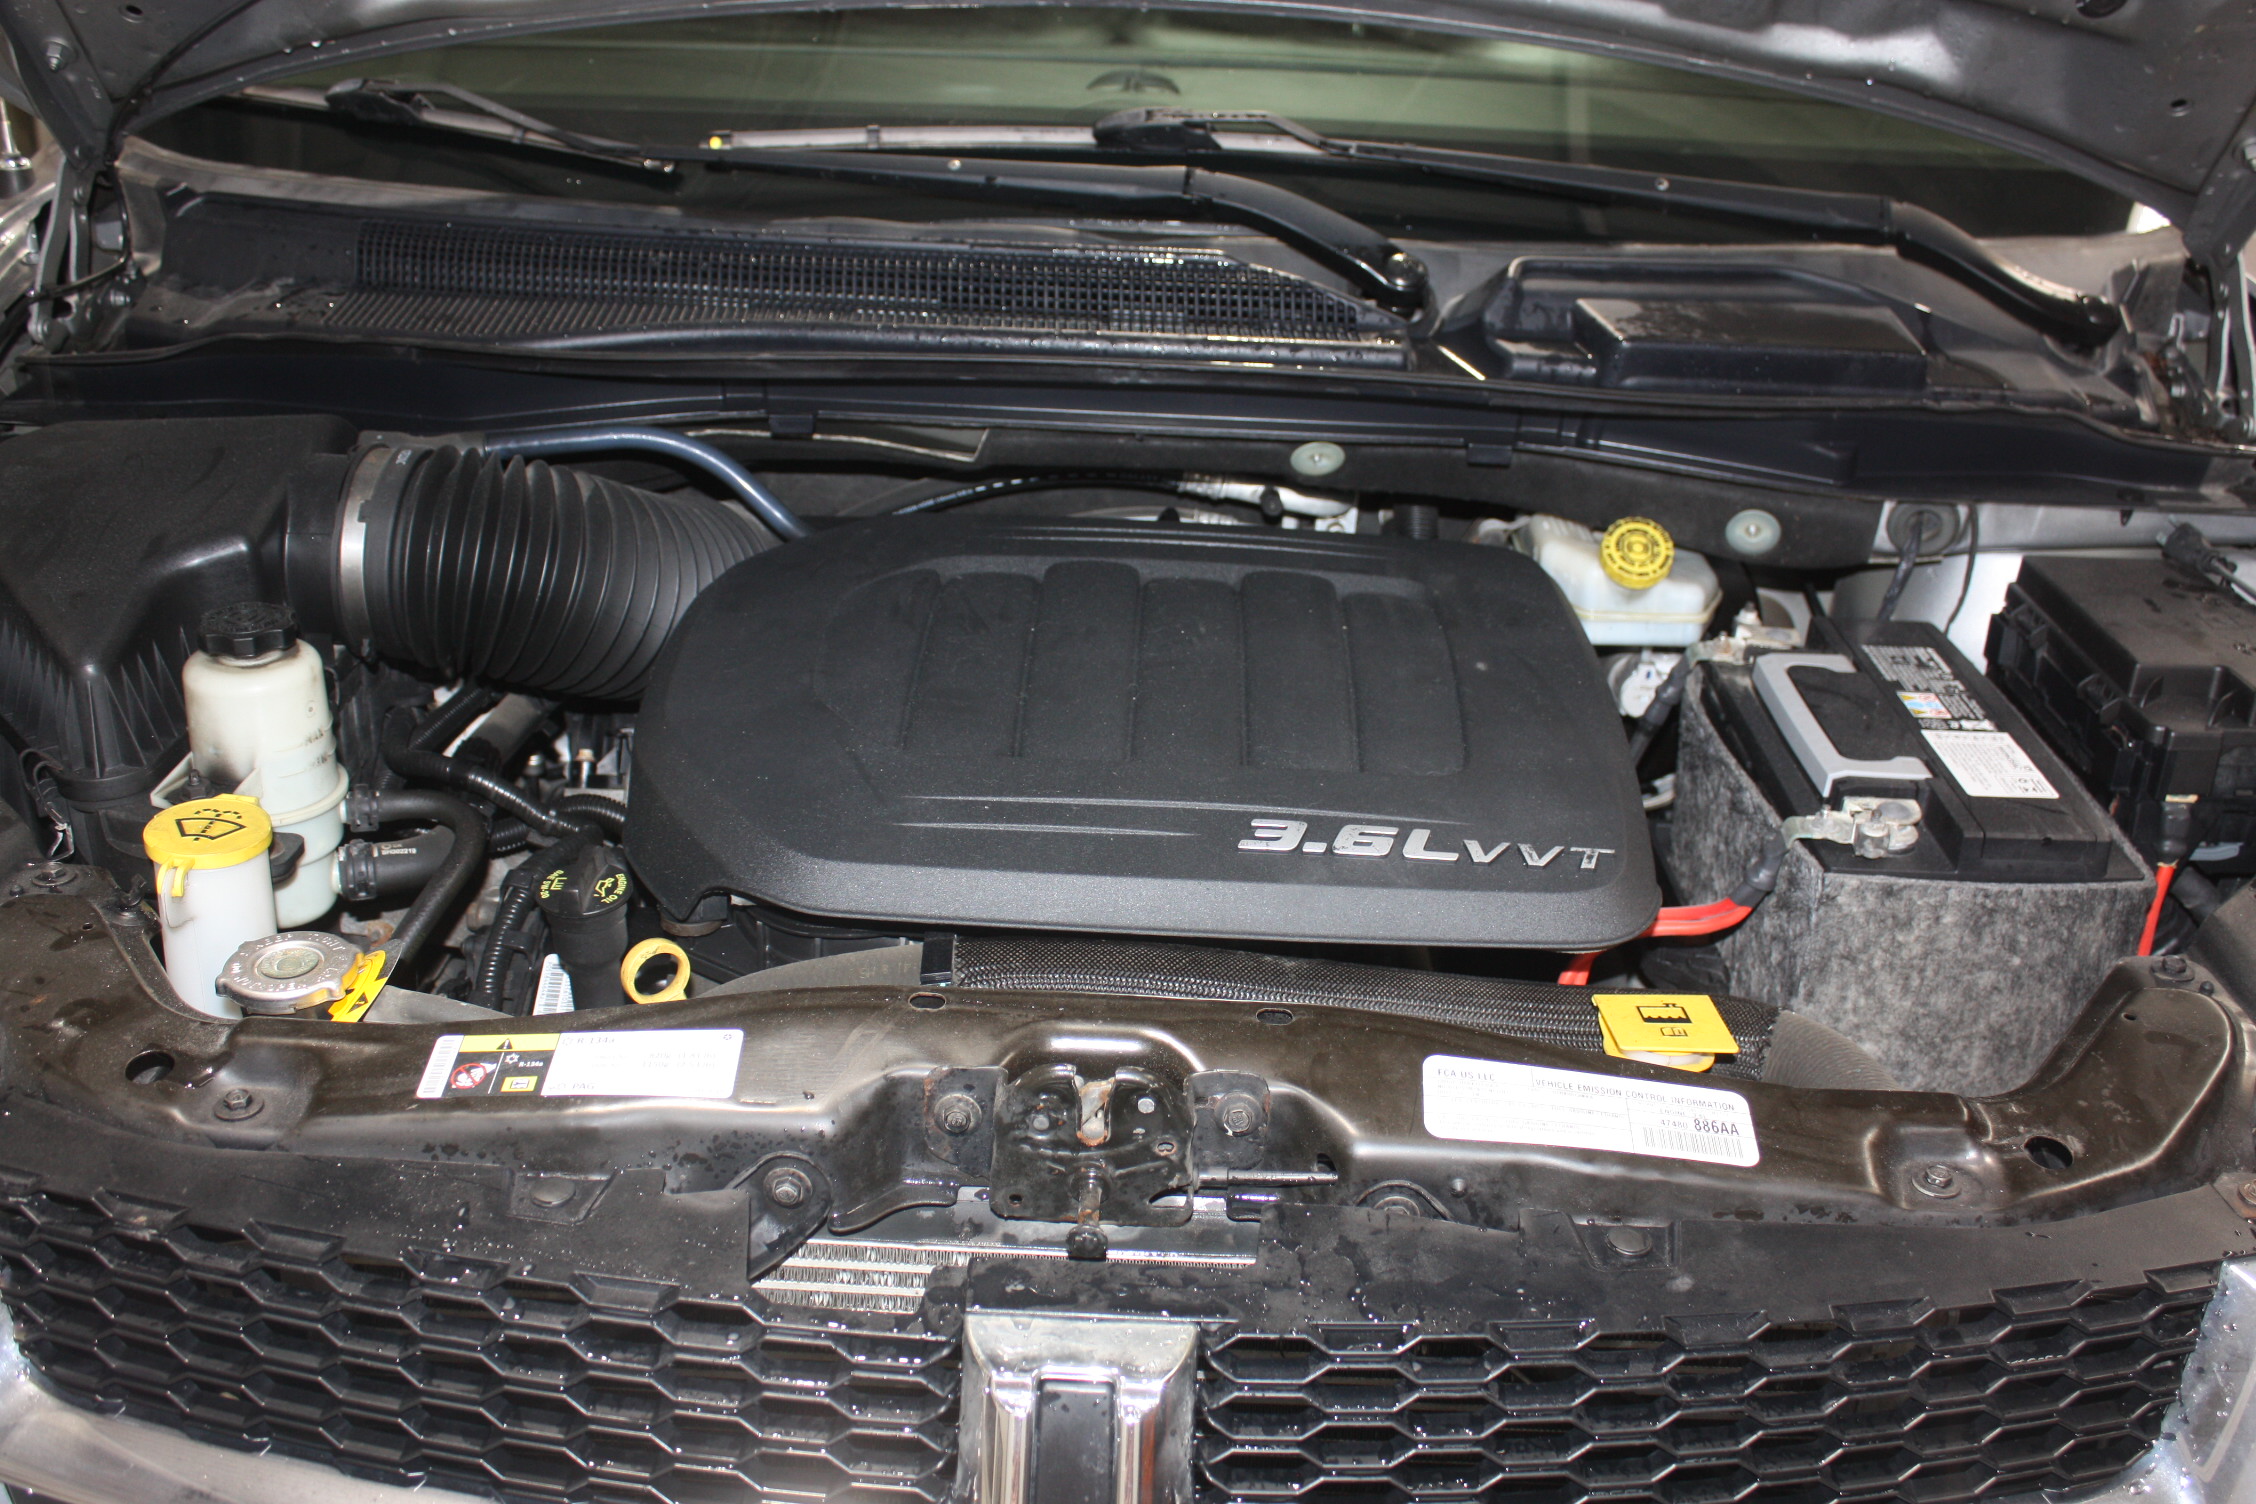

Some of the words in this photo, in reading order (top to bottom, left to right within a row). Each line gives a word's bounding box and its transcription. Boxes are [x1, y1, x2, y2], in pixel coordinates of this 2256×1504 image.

[1237, 818, 1459, 862] 3.6L
[1463, 838, 1616, 870] VVT
[613, 873, 628, 895] ENGINE
[600, 894, 618, 904] OIL
[518, 1060, 544, 1068] R-134a
[1437, 1068, 1457, 1078] FCA
[1460, 1070, 1474, 1080] US
[1535, 1079, 1574, 1091] VEHICLE
[1577, 1084, 1622, 1097] EMISSION
[1625, 1090, 1668, 1103] CONTROL
[1671, 1096, 1736, 1111] INFORMATION
[1693, 1117, 1740, 1136] 886AA
